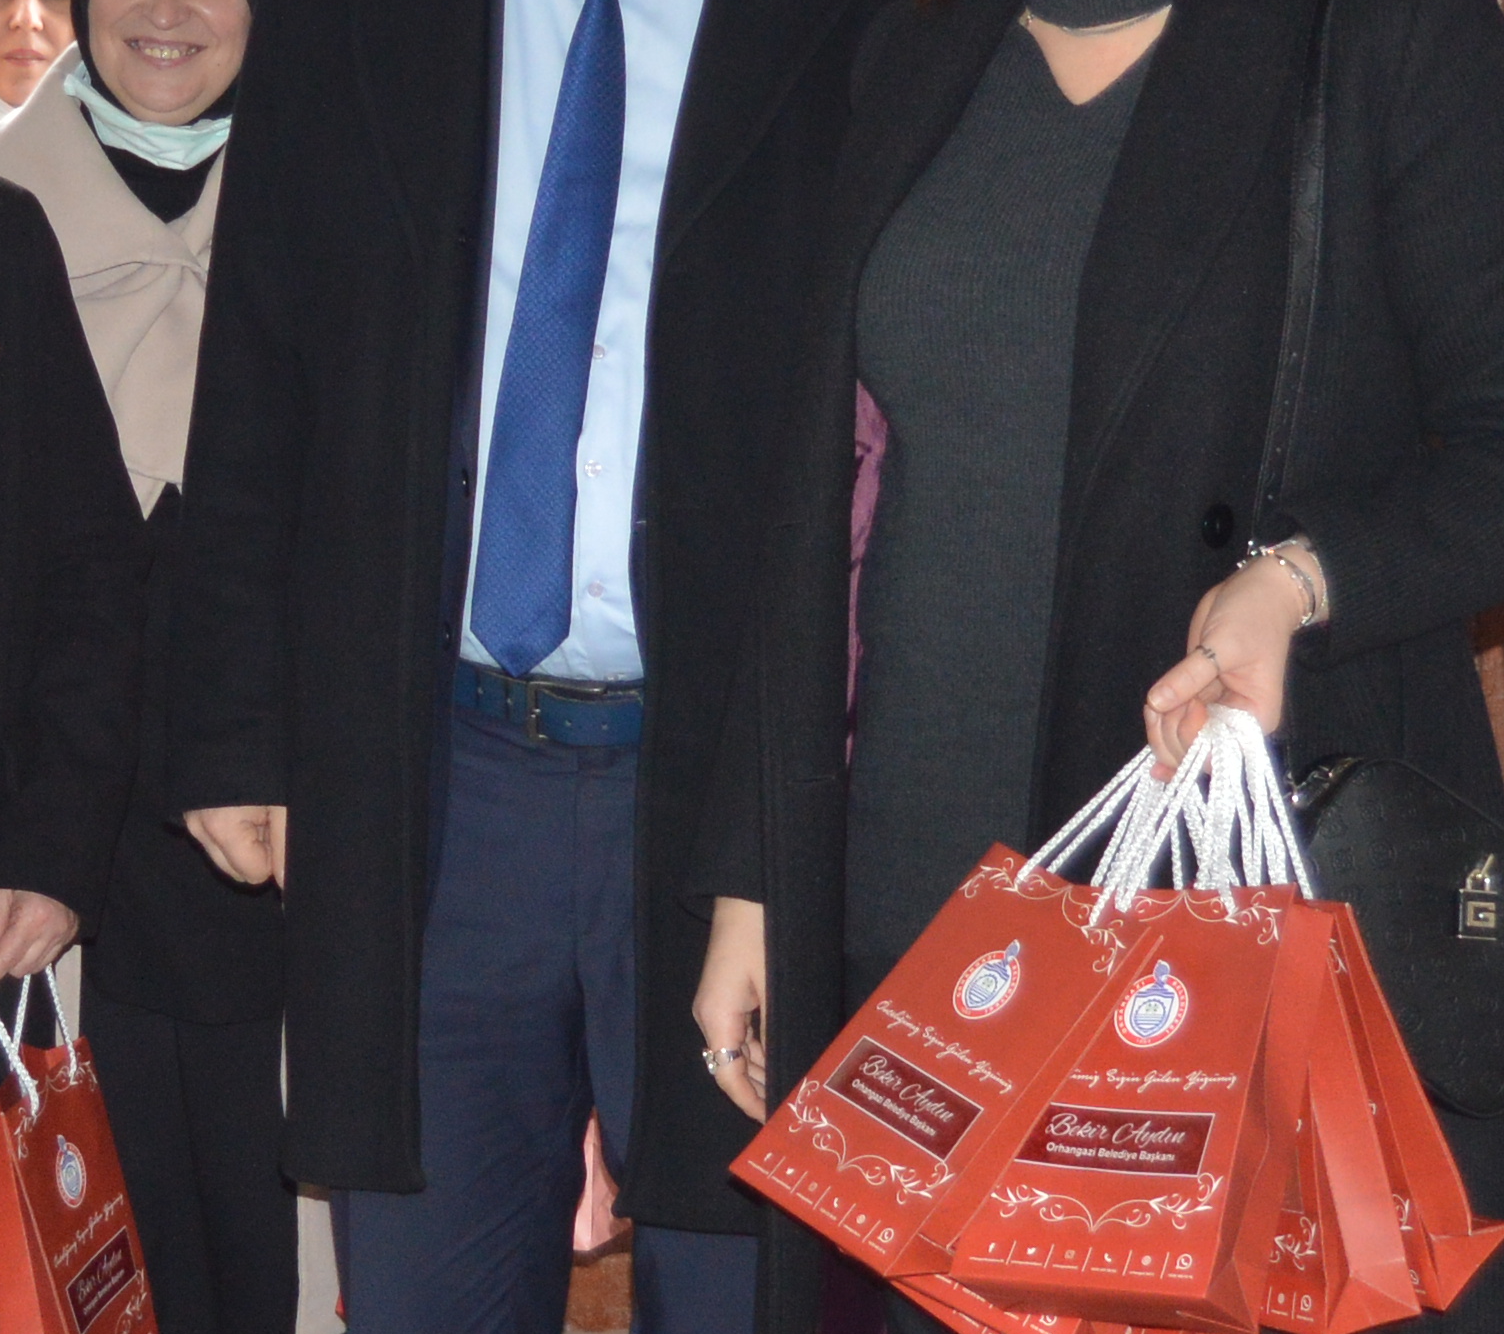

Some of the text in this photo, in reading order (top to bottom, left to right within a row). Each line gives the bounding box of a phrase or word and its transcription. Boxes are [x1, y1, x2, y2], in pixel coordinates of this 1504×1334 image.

[936, 1043, 972, 1064] Gülen
[861, 1055, 955, 1123] Bekir Aydın
[1107, 1068, 1141, 1090] Sizin
[1137, 1070, 1180, 1093] Gülen
[852, 1078, 937, 1137] Orhangazi Belediye Başkanı
[1045, 1113, 1186, 1149] Bekir Aydın
[1046, 1142, 1175, 1163] Orhangazi Belediye Başkanı
